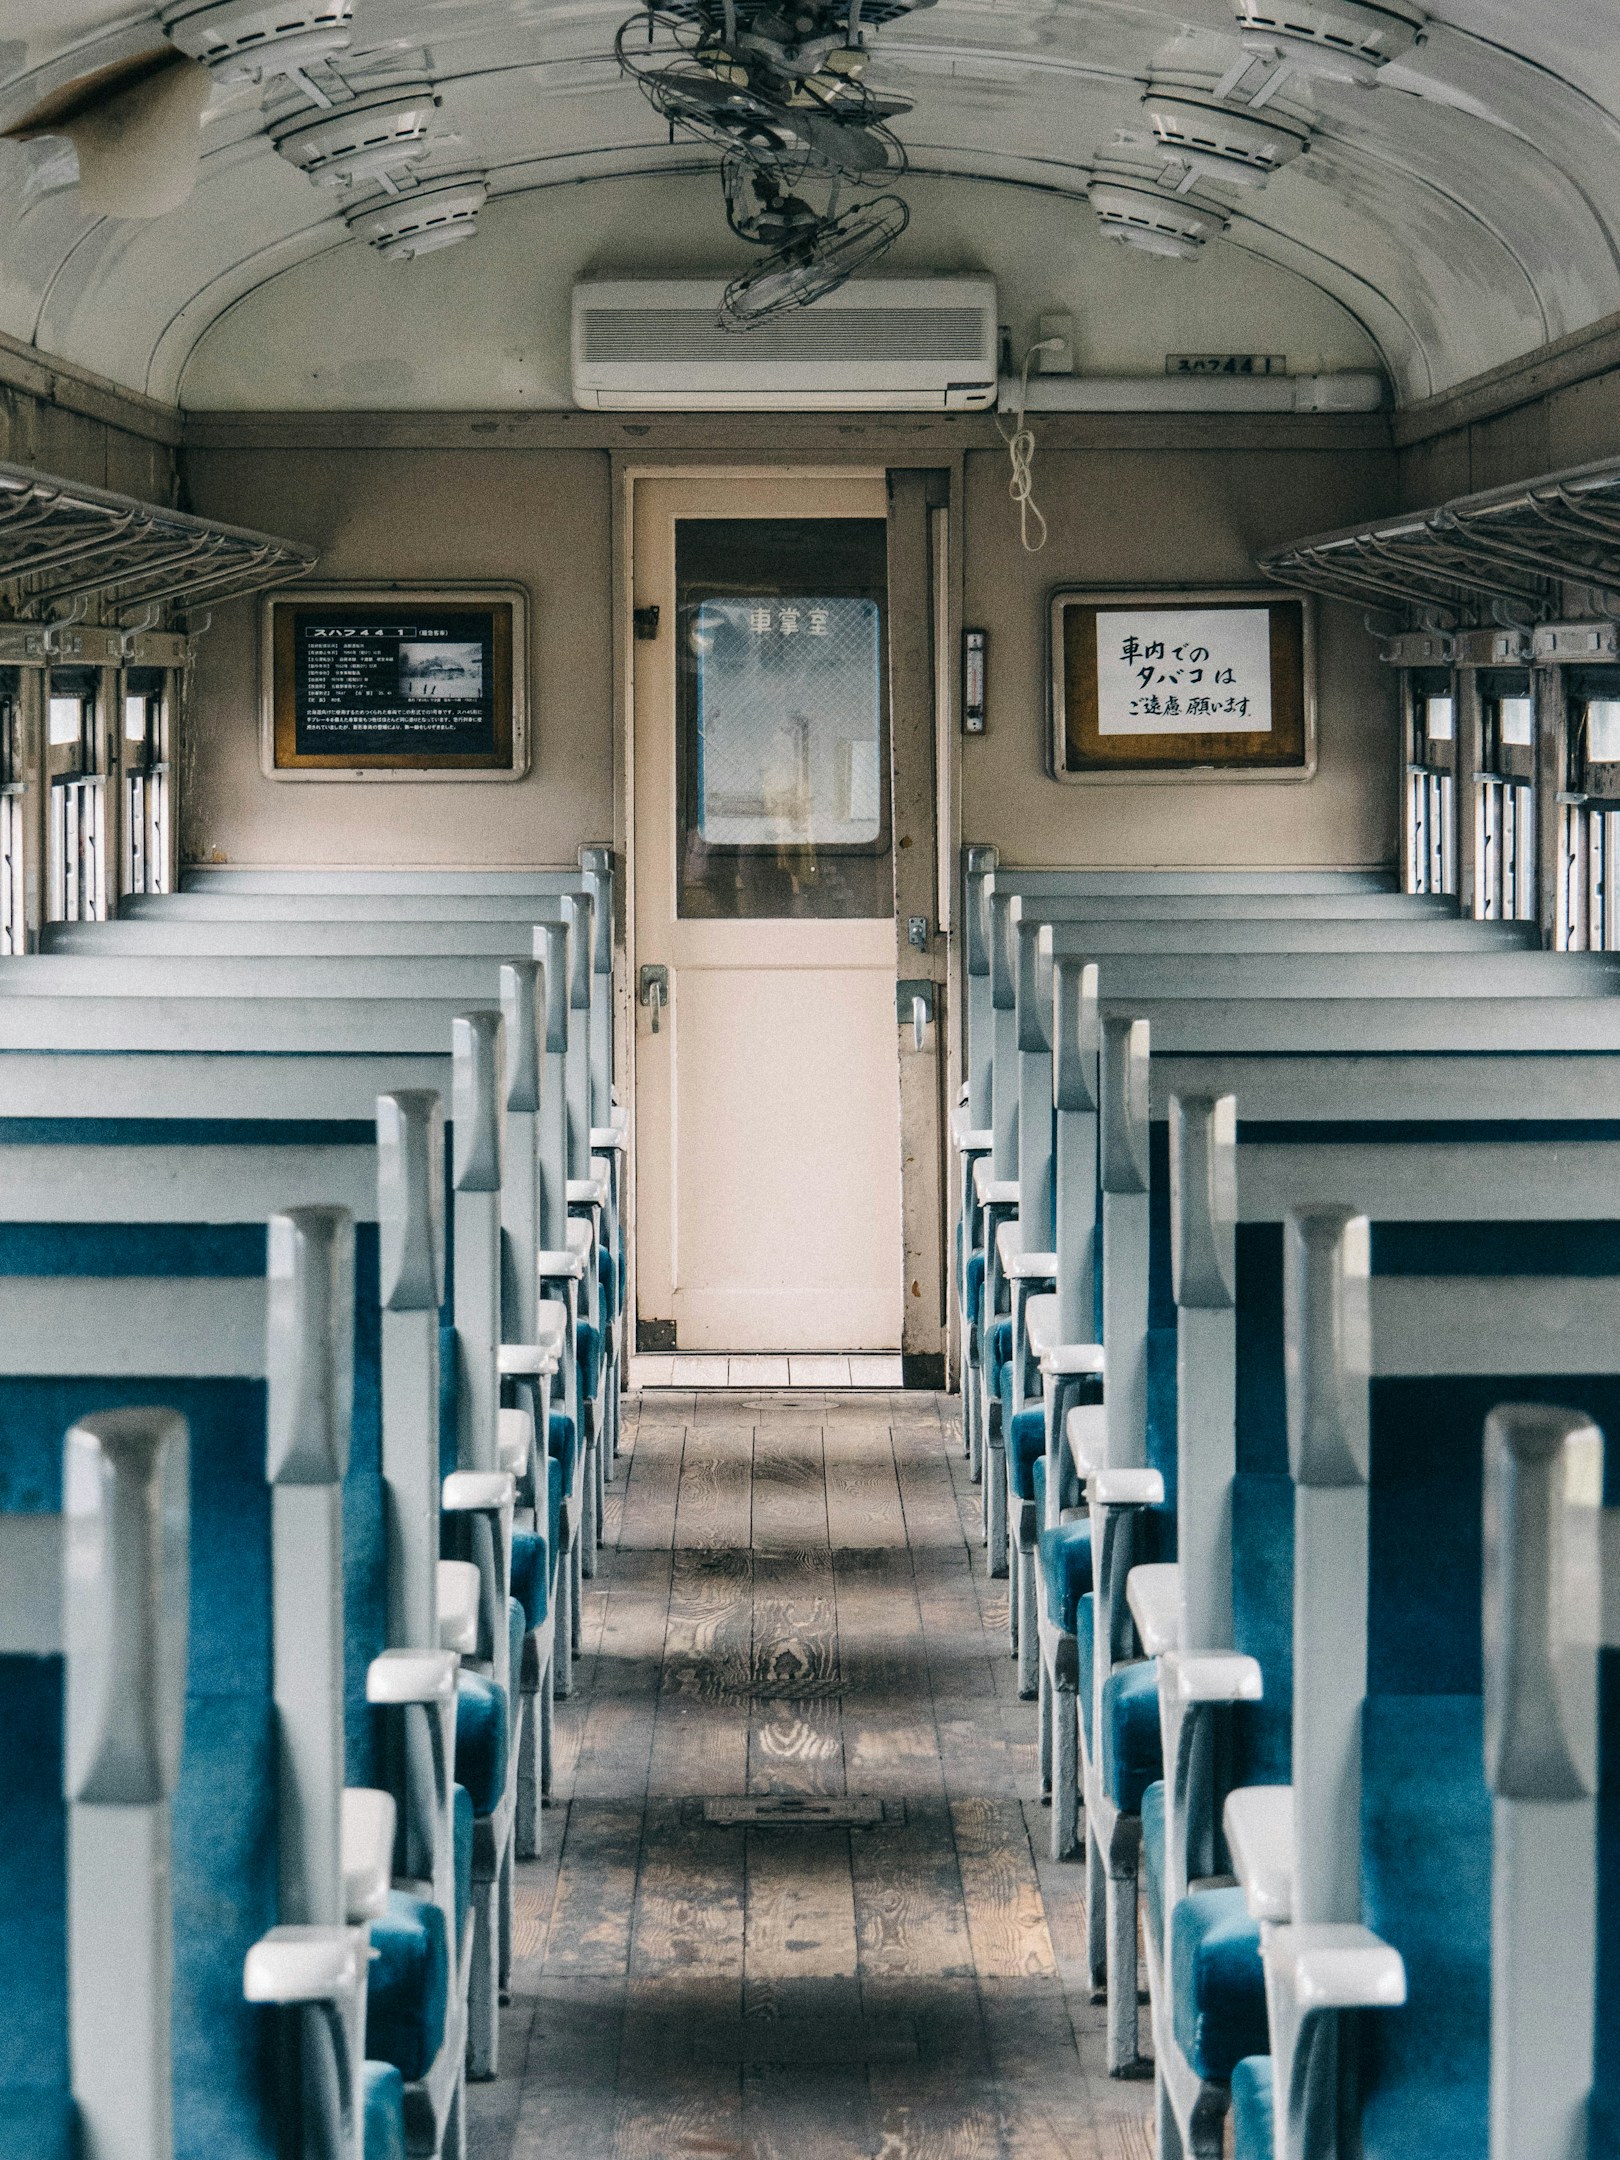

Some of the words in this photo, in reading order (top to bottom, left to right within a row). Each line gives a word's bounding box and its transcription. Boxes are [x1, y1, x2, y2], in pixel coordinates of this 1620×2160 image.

[313, 629, 384, 637] スハフ44
[749, 607, 829, 636] 車掌室
[1119, 635, 1210, 666] 車内での
[1137, 666, 1237, 689] タバコは
